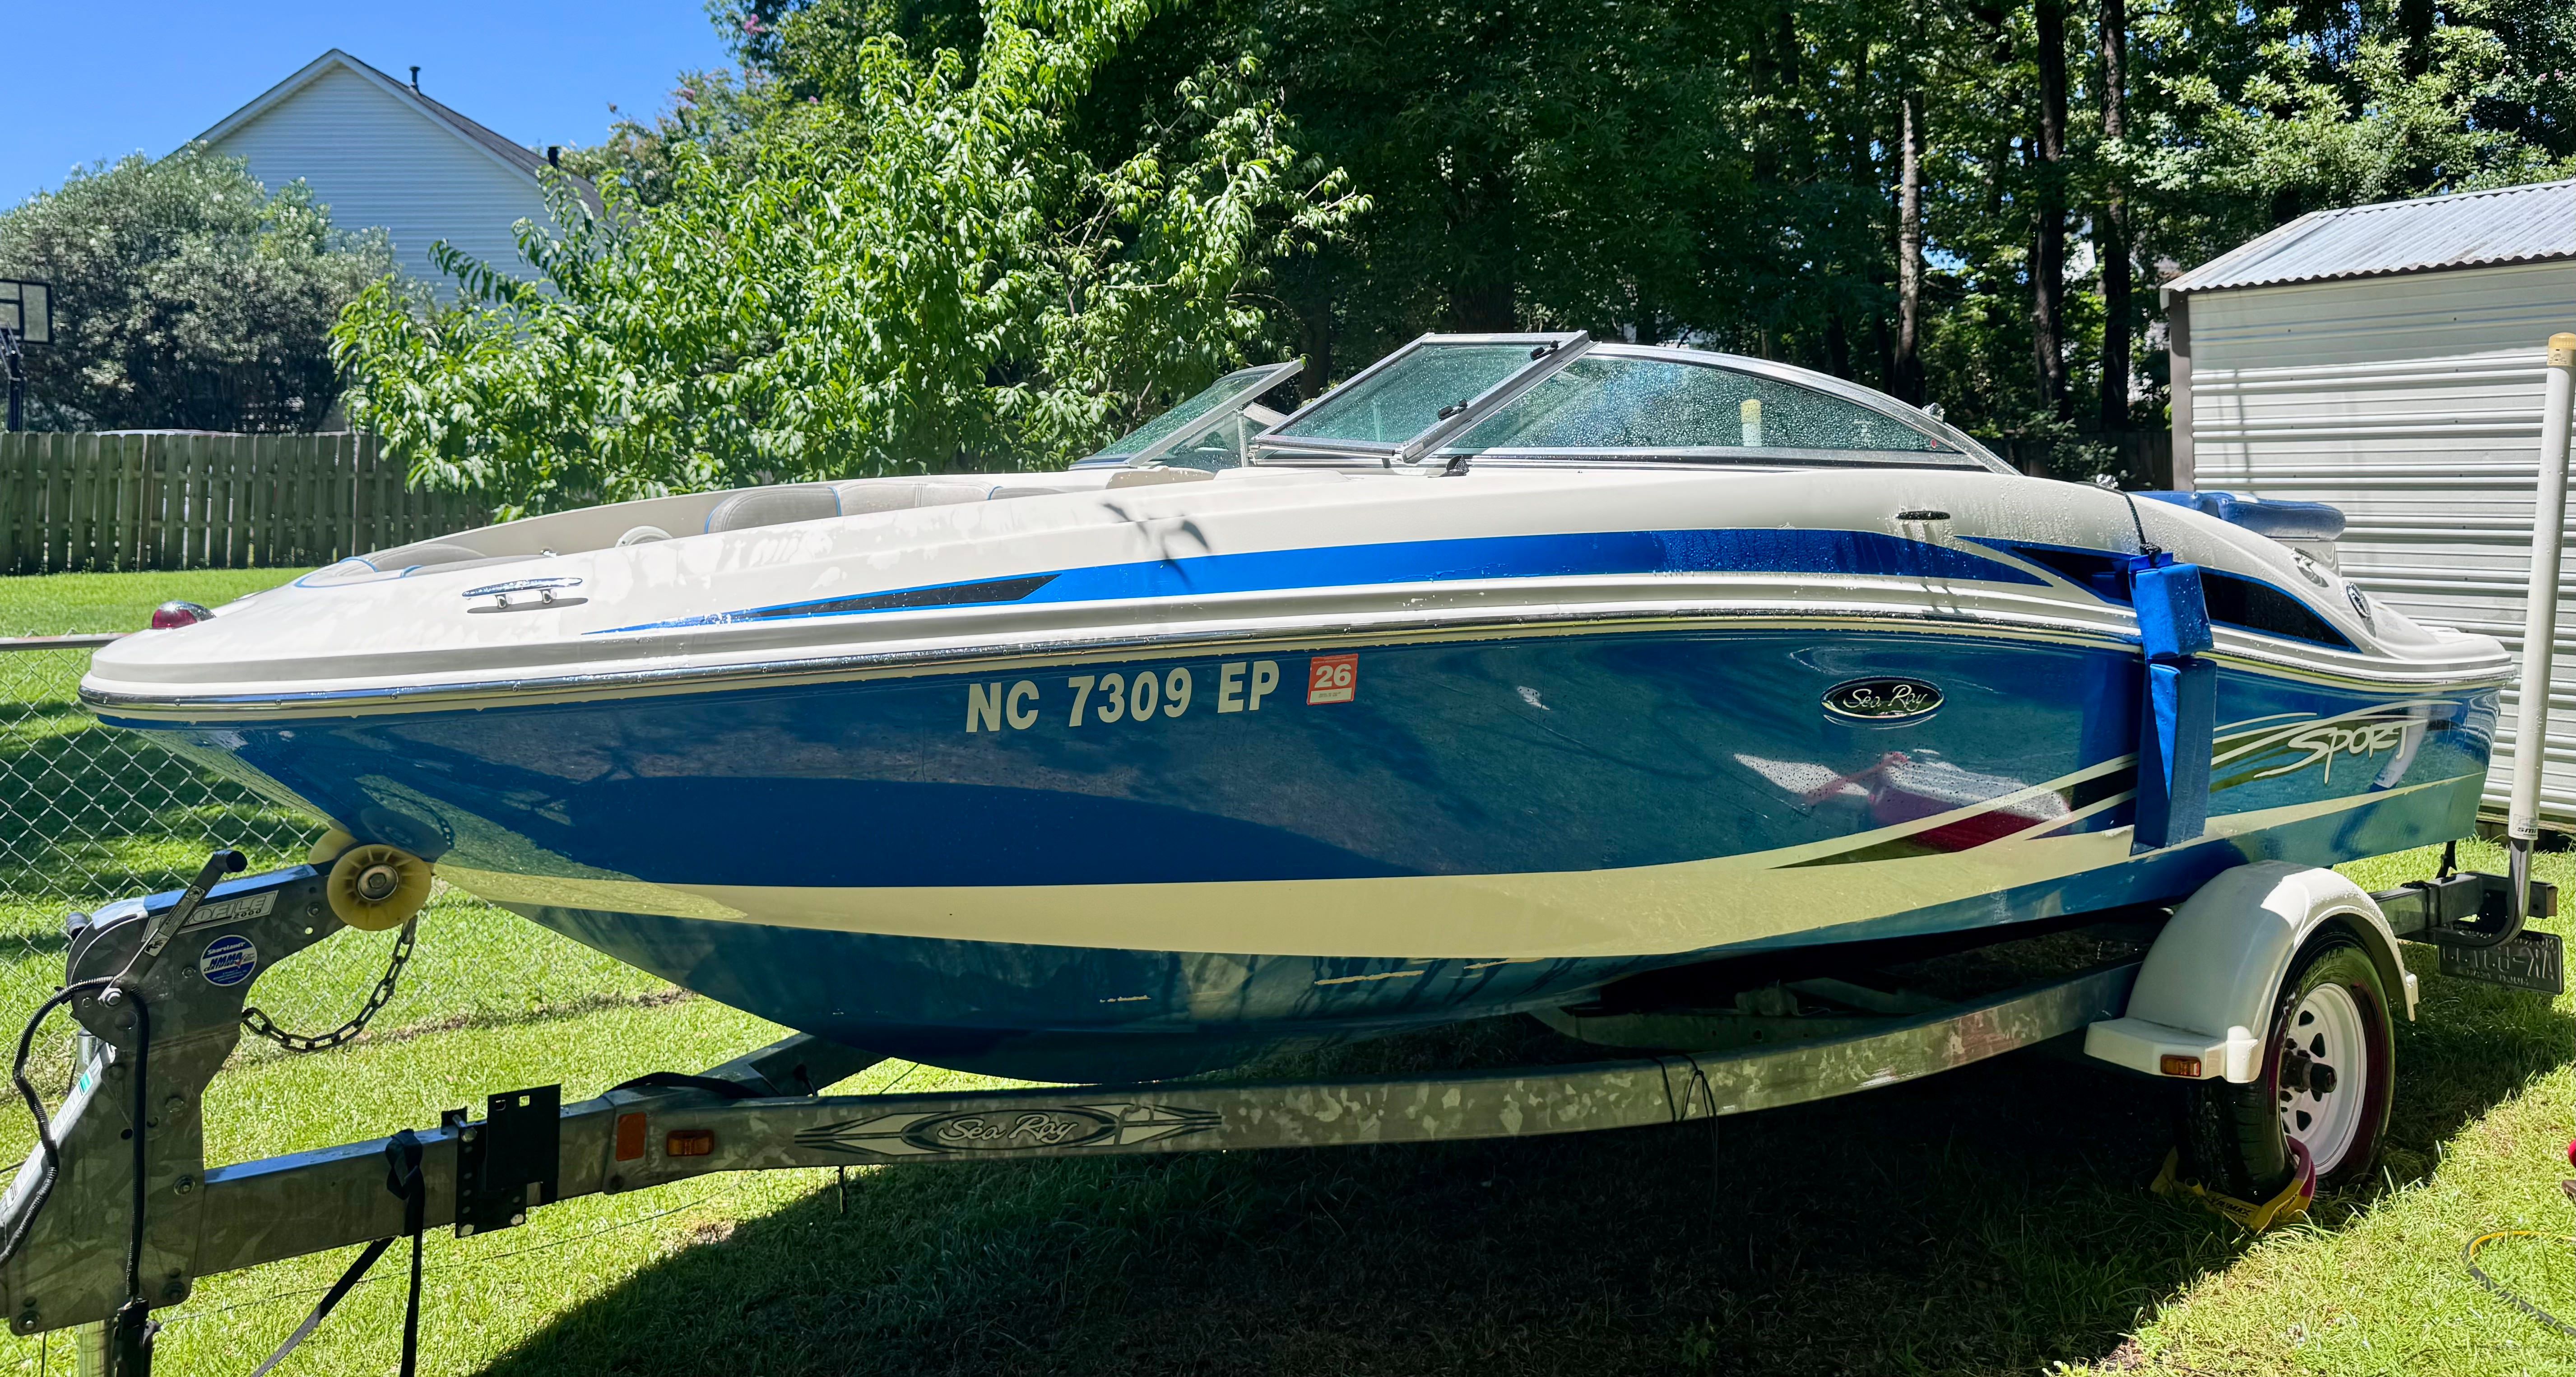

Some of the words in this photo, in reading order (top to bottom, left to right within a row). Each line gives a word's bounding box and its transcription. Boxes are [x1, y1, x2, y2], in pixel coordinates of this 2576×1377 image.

[1314, 664, 1351, 688] 26
[965, 679, 1039, 733] NC
[1068, 667, 1193, 727] 7309
[1217, 660, 1280, 713] EP
[1843, 688, 1881, 708] Sea
[1888, 684, 1928, 712] Ray
[2254, 719, 2428, 784] SPORT
[232, 909, 262, 919] 2000
[938, 1118, 1006, 1140] Sea
[1008, 1112, 1079, 1144] Ray
